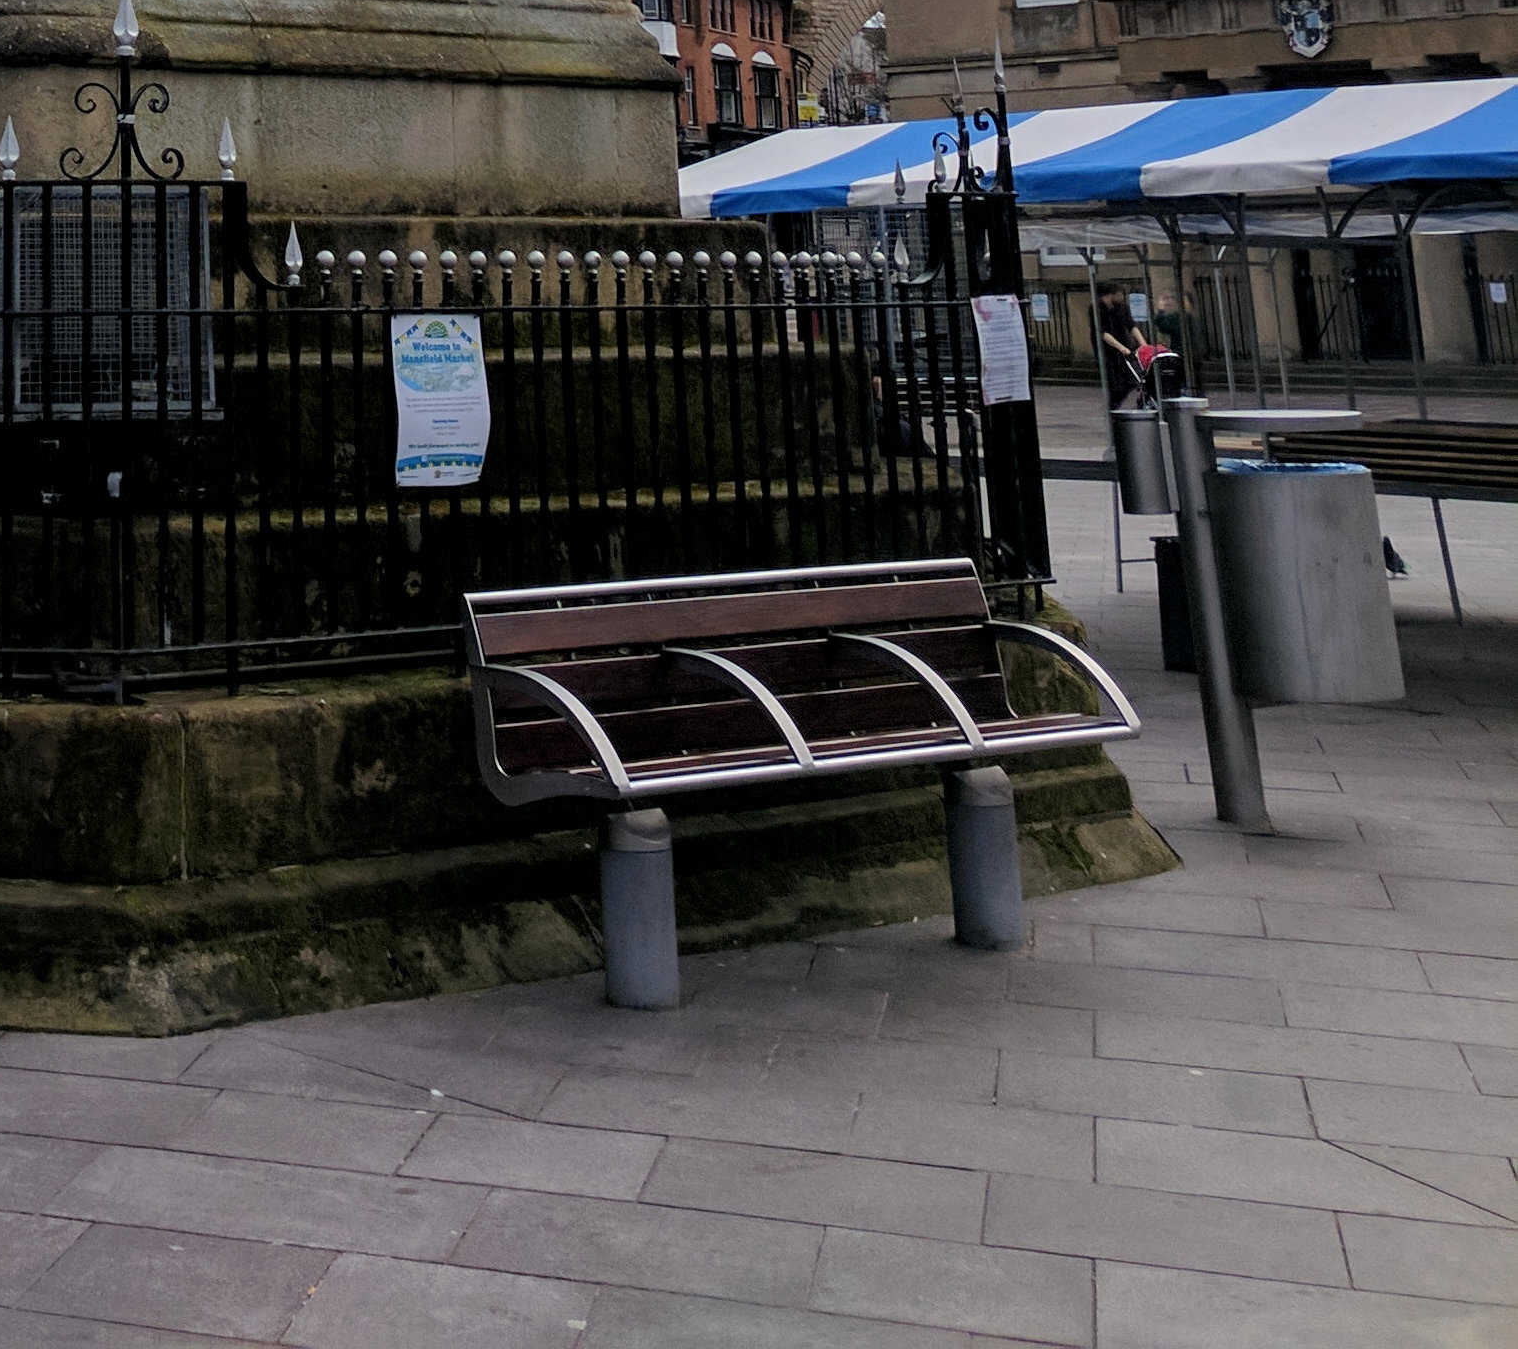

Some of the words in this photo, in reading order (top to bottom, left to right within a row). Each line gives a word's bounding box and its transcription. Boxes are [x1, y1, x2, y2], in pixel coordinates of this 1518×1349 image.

[412, 342, 451, 351] Welcome
[452, 342, 461, 351] to
[401, 353, 442, 364] Mansfield
[444, 353, 475, 363] Market
